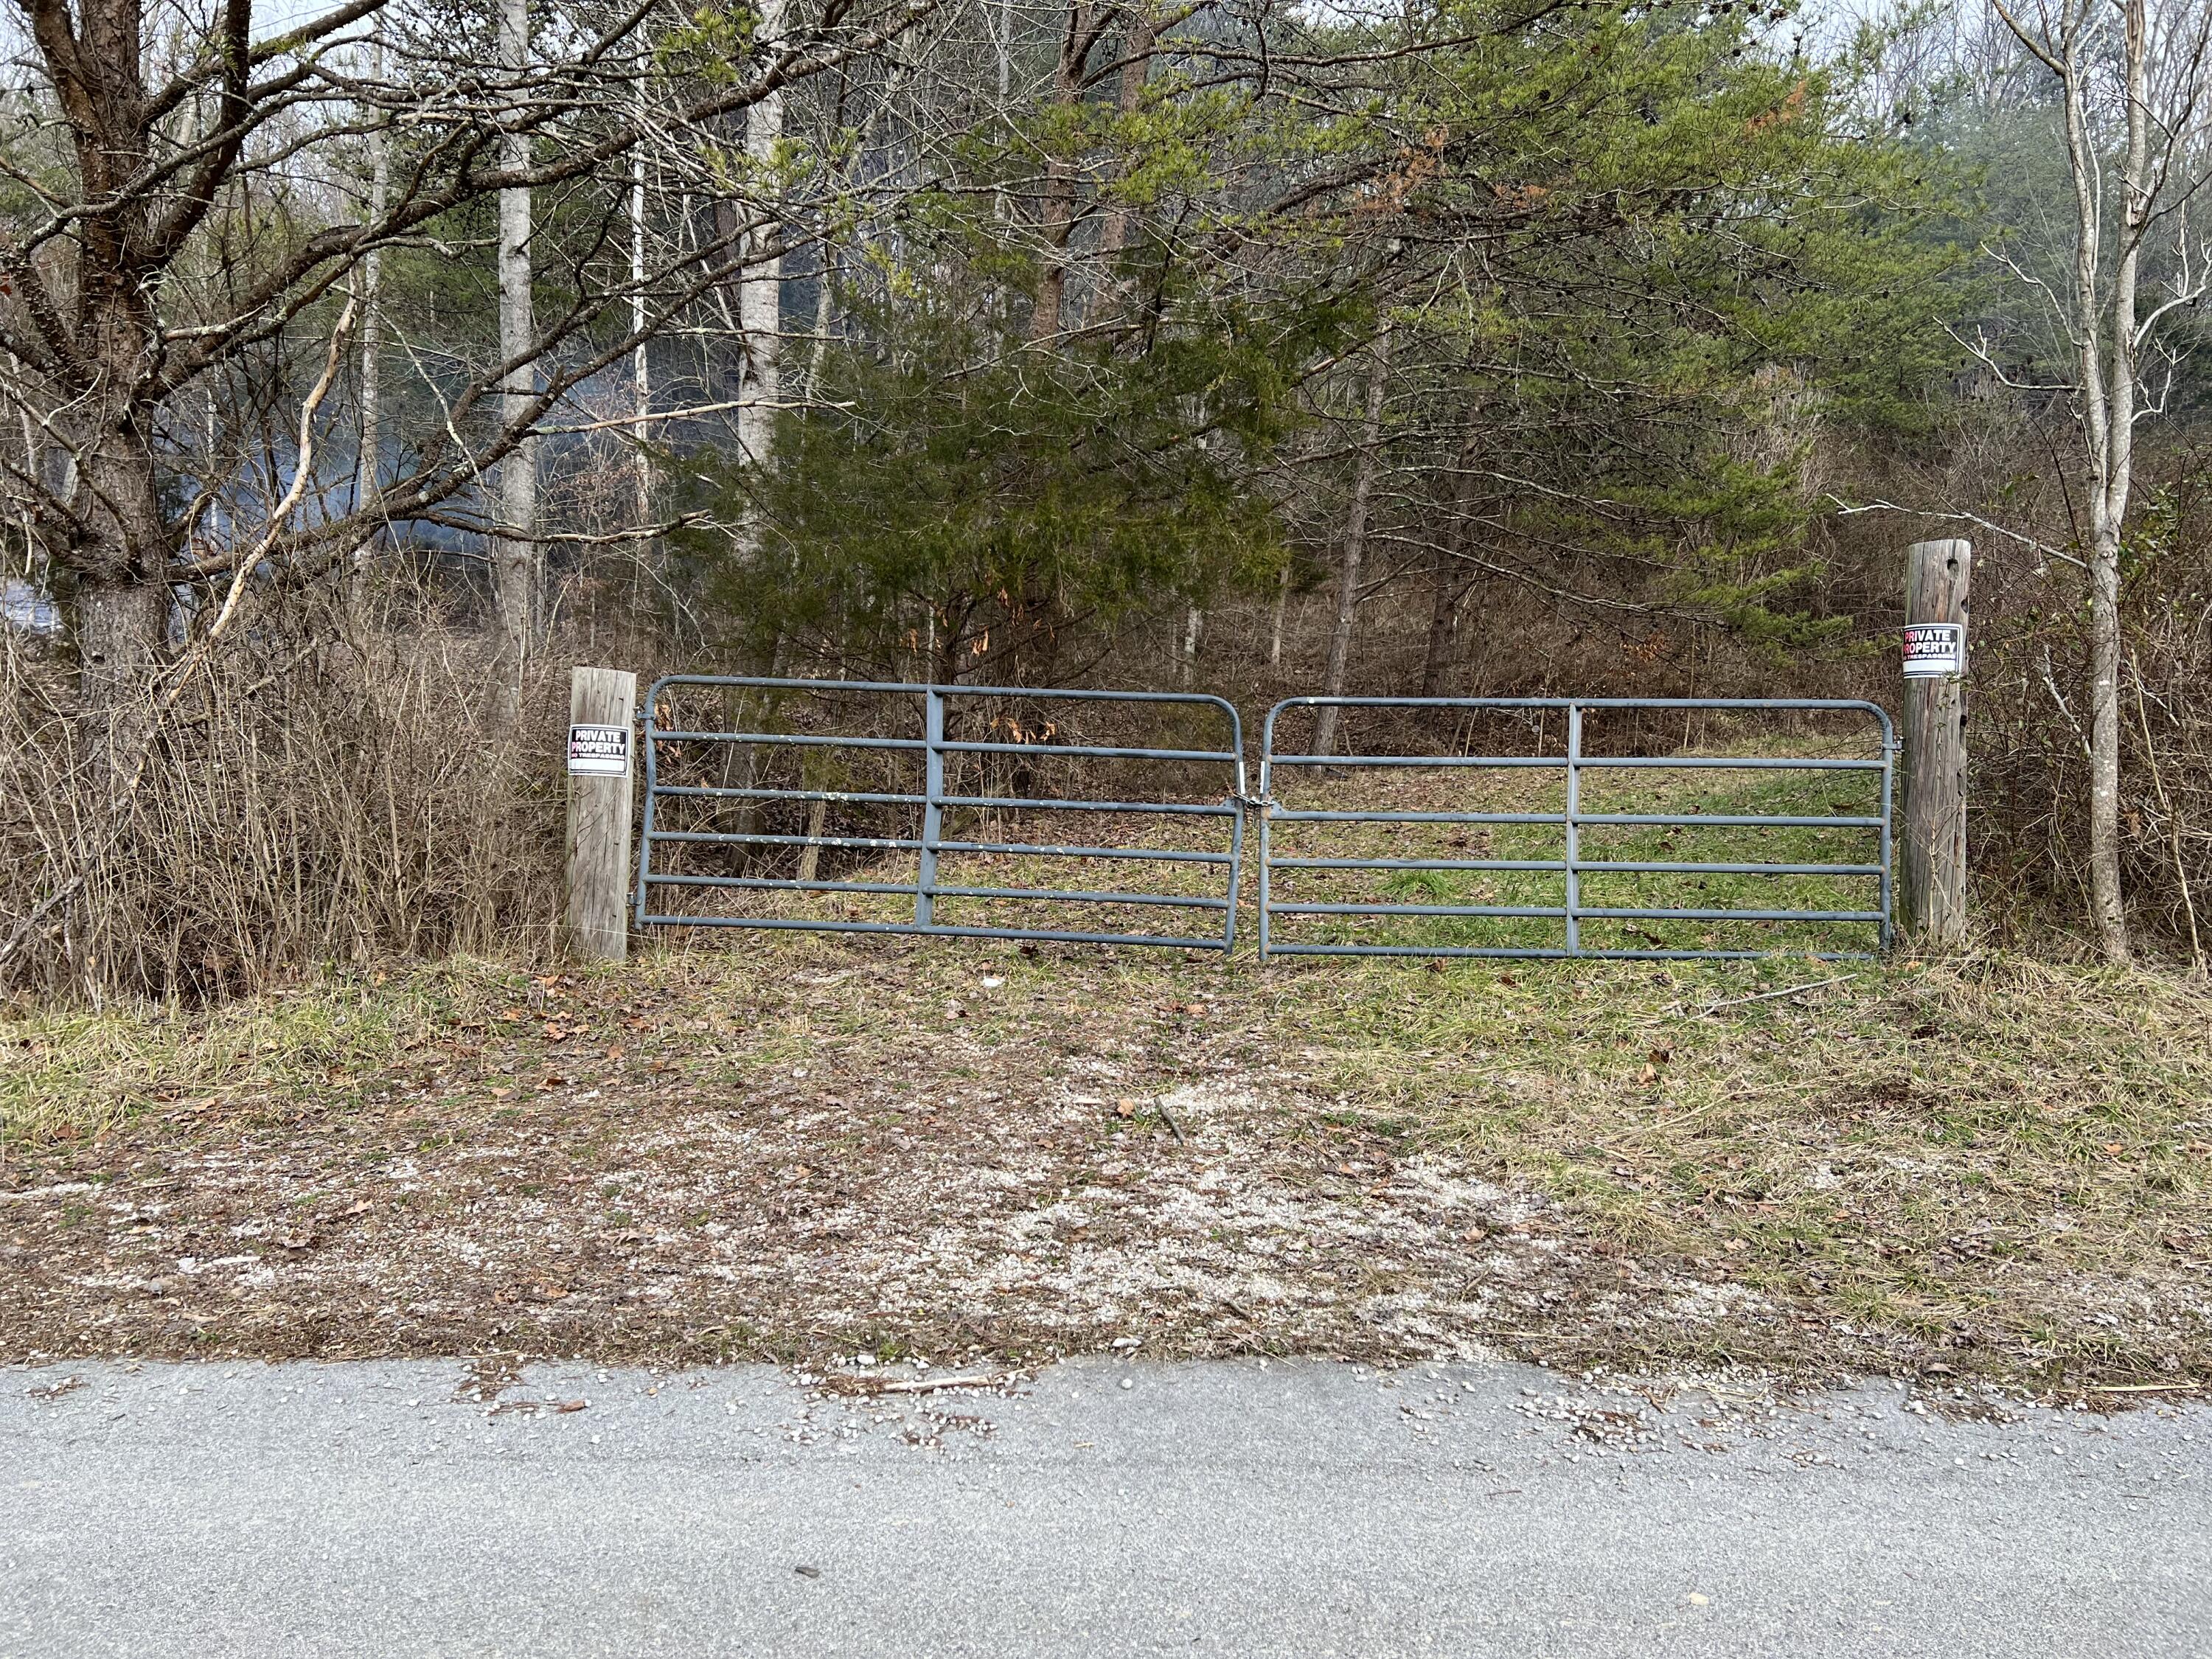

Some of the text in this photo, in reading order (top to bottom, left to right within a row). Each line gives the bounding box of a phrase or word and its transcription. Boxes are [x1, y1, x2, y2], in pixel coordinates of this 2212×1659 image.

[1905, 630, 1950, 642] PRIVATE
[576, 730, 620, 742] PRIVATE
[571, 741, 625, 754] PROPERTY
